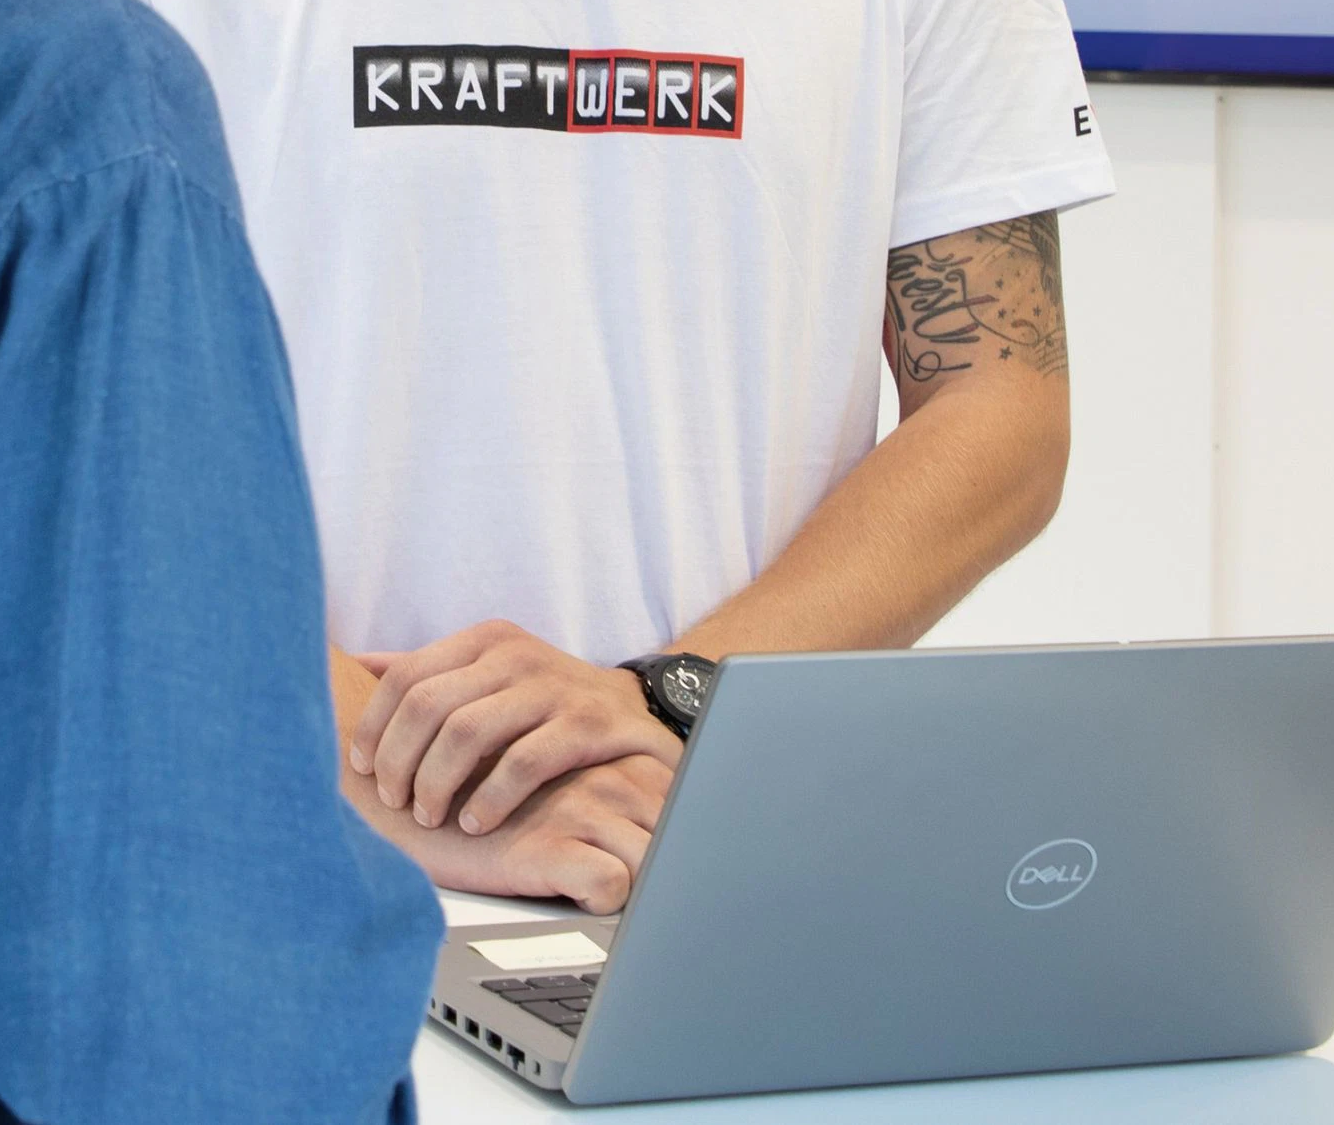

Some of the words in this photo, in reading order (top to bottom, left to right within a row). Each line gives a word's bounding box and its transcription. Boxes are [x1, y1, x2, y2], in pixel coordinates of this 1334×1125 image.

[367, 61, 735, 123] KRAFTWERK
[1073, 104, 1097, 137] E
[1018, 864, 1083, 884] DELL
